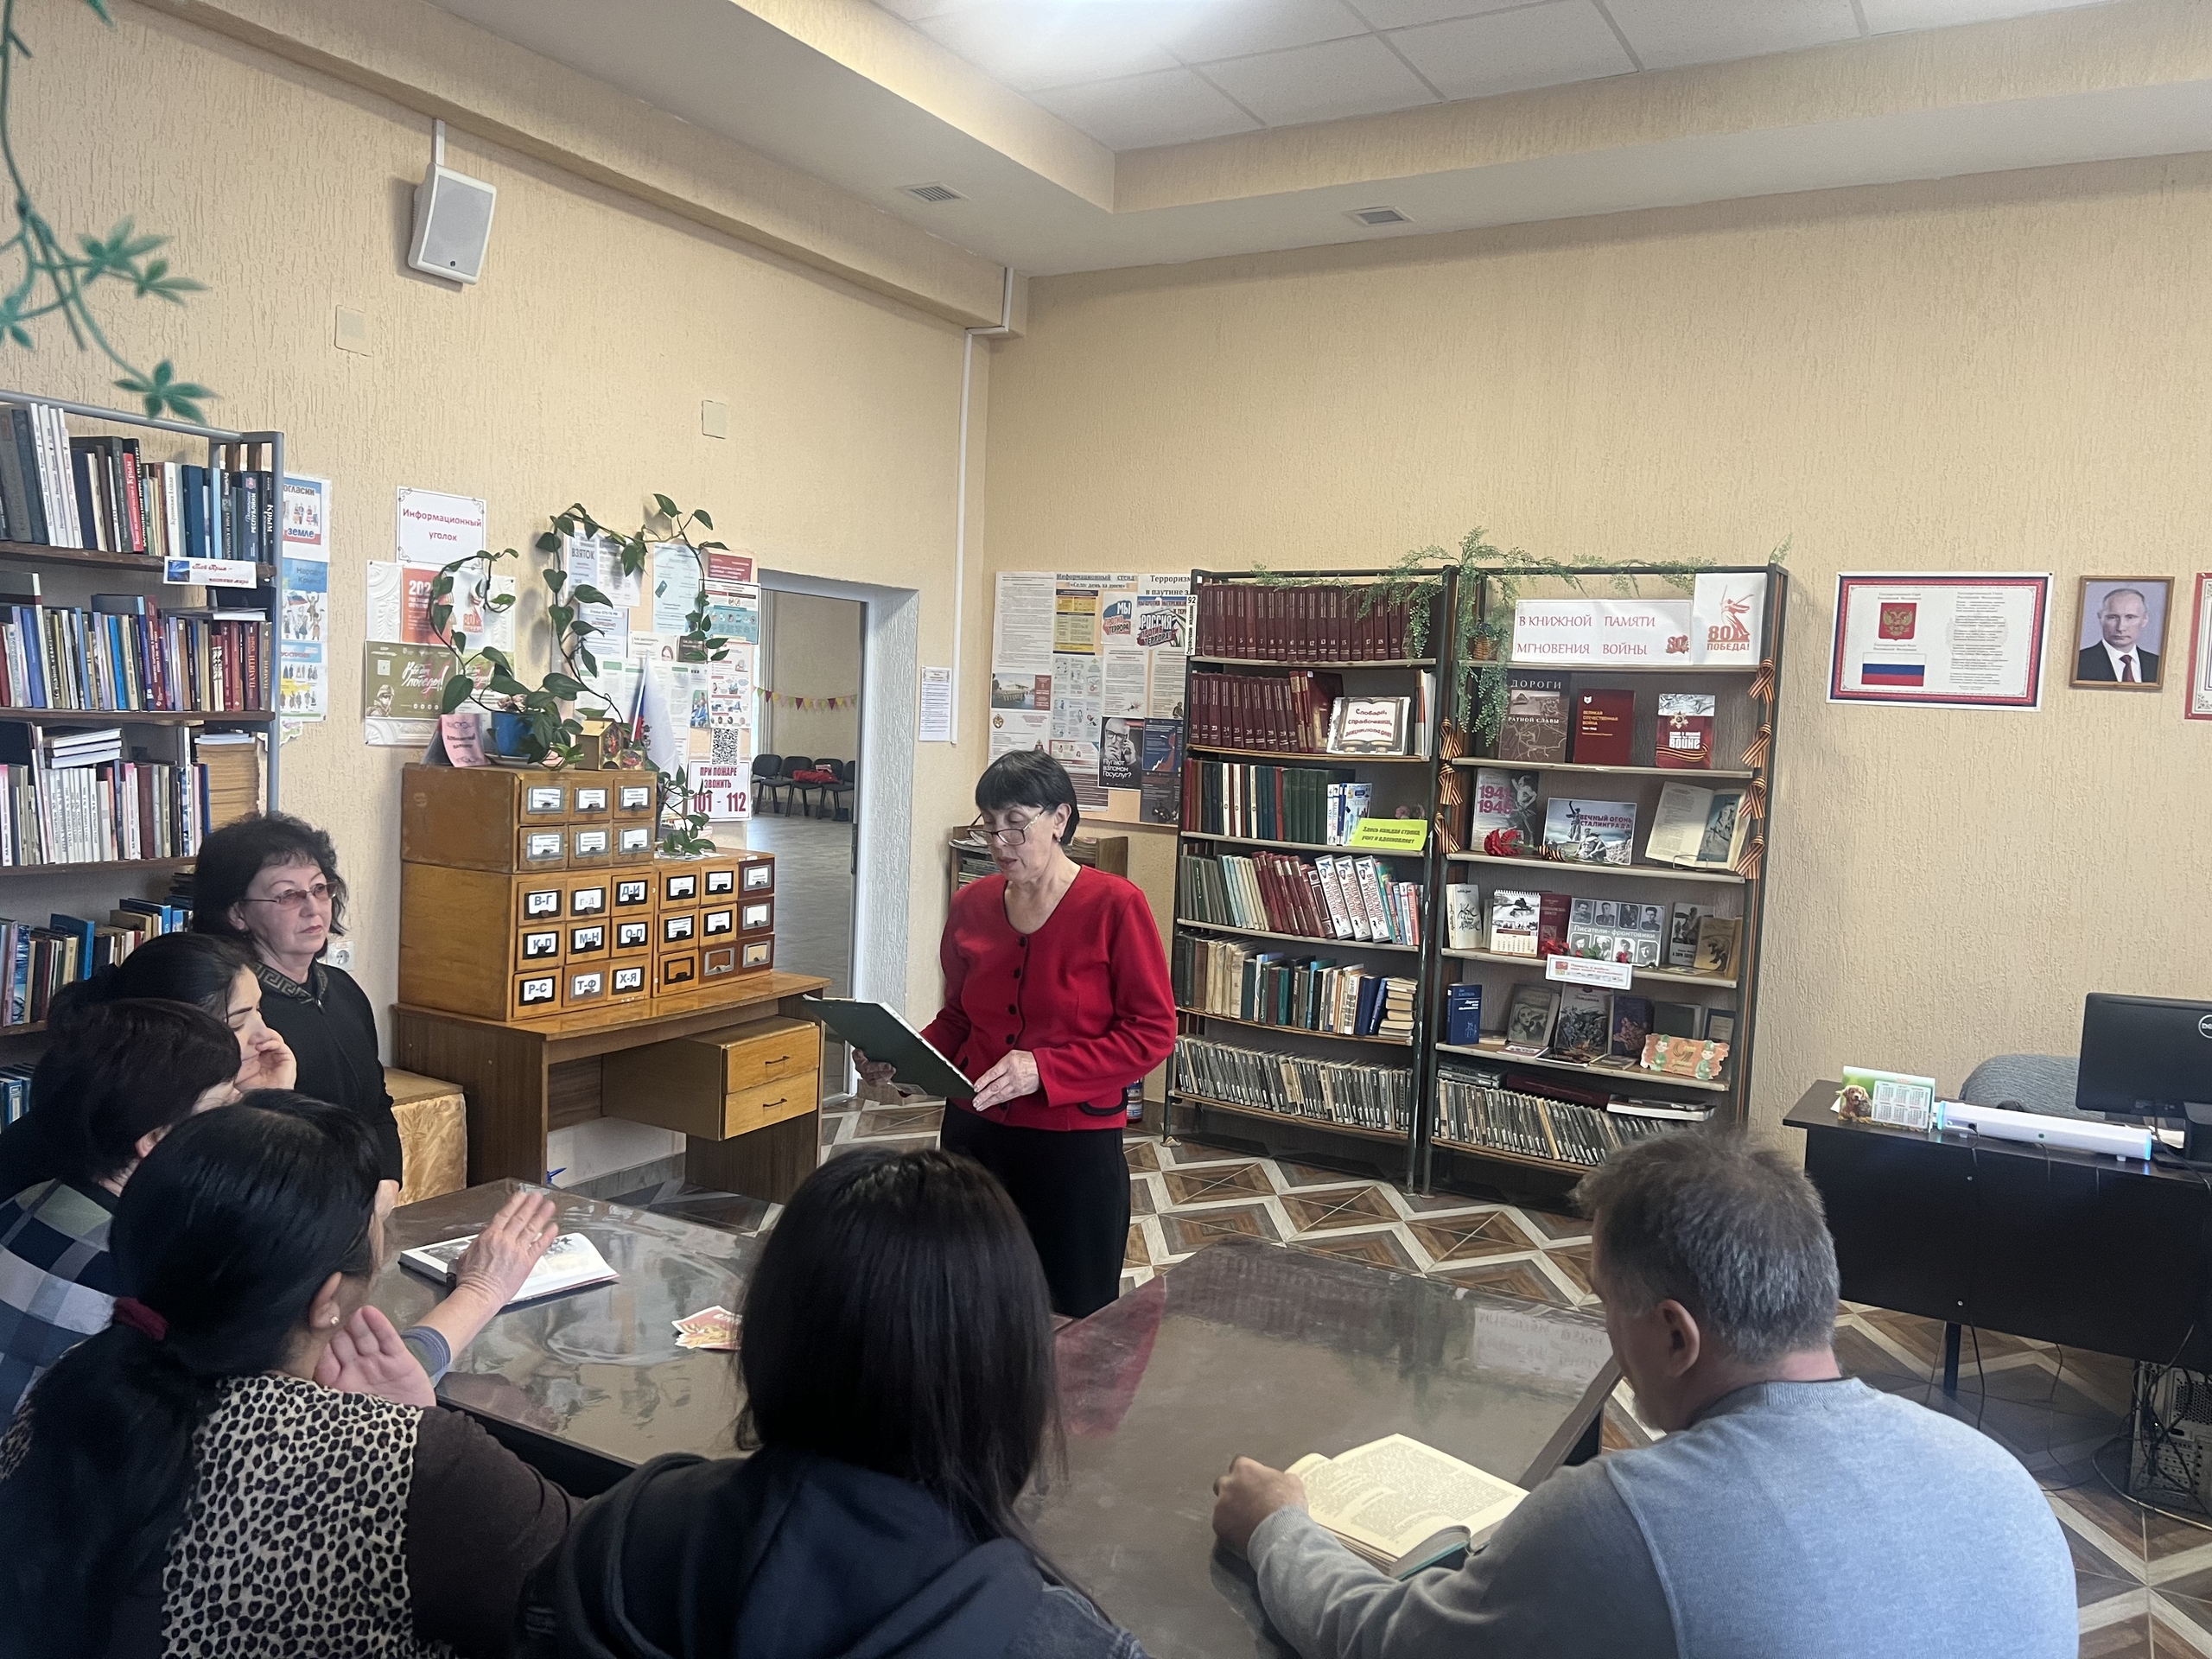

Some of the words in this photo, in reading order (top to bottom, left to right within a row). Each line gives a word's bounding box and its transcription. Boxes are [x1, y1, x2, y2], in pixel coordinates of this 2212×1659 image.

[283, 484, 315, 496] огласии
[263, 505, 274, 532] Крым
[403, 508, 482, 527] Информационный
[287, 527, 315, 539] земле
[429, 531, 458, 542] уголок
[571, 548, 595, 561] ВЗЯТОК
[409, 580, 431, 596] 202
[1117, 602, 1131, 615] МЫ
[1141, 614, 1173, 630] РОССИЯ
[1519, 615, 1526, 626] В
[1529, 613, 1592, 627] КНИЖНОЙ
[1604, 616, 1656, 627] ПАМЯТИ
[1109, 624, 1129, 633] ТЕРРОРА
[1141, 626, 1163, 638] ПРОТИВ
[1707, 626, 1732, 640] 80
[1516, 643, 1590, 654] МГНОВЕНИЯ
[1602, 642, 1648, 655] ВОЙНЫ
[1707, 643, 1750, 652] ПОБЕДА!
[1510, 679, 1561, 690] ДОРОГИ
[1103, 758, 1125, 766] Пугают
[700, 766, 712, 776] ПРИ
[713, 767, 737, 776] ПОЖАРЕ
[1103, 771, 1132, 779] Госуслуг?
[704, 779, 732, 788] ЗВОНИТЬ
[694, 792, 712, 812] 101
[727, 792, 747, 812] 112
[1478, 799, 1514, 815] 1945
[1580, 821, 1631, 830] СТАЛИНГРАДА
[534, 894, 553, 906] В-Г
[579, 932, 600, 944] М-Н
[626, 928, 643, 938] О-П
[1573, 925, 1611, 934] Писатели-
[1611, 929, 1656, 939] фронтовики
[620, 973, 637, 983] Х-Я
[528, 982, 547, 995] Р-С
[577, 979, 596, 990] Т-Ф
